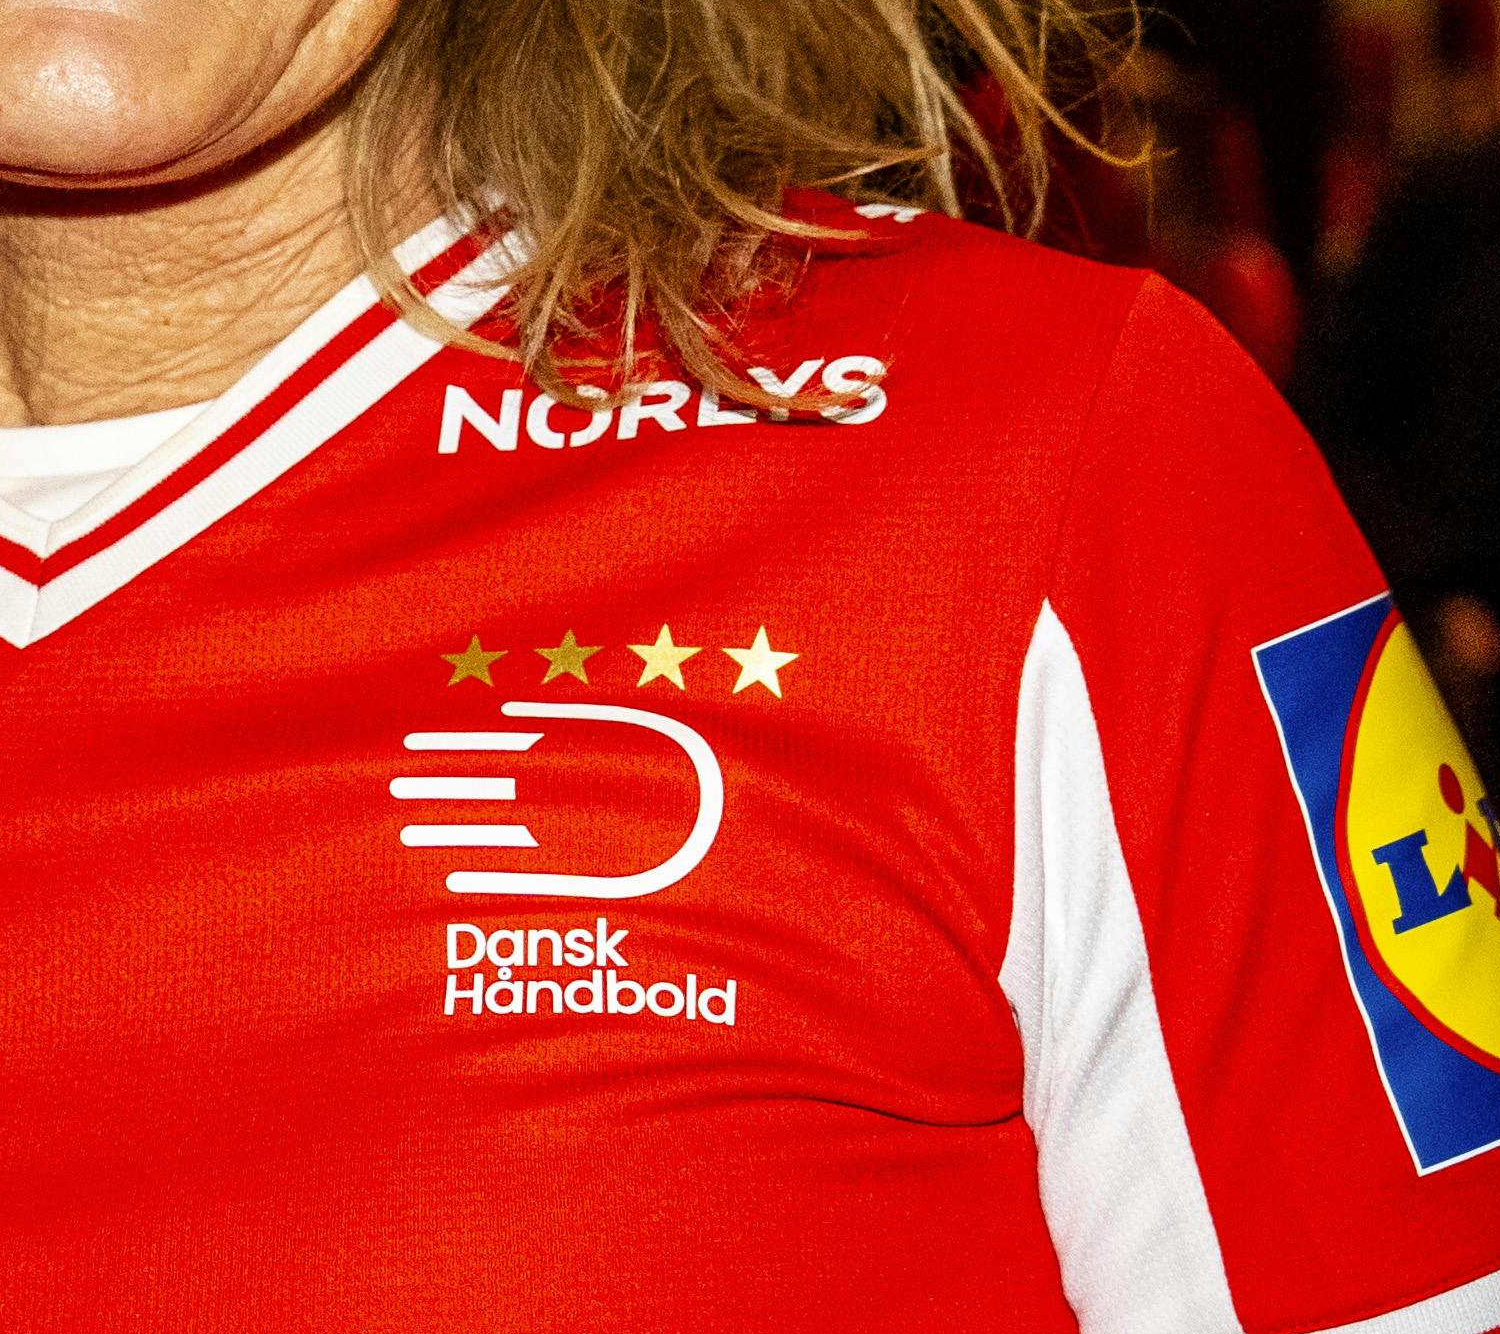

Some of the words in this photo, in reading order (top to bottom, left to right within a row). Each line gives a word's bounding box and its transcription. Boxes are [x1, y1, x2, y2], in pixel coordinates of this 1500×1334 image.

[437, 355, 889, 454] NORLYS
[446, 917, 630, 969] Dansk
[443, 966, 738, 1027] Håndbold
